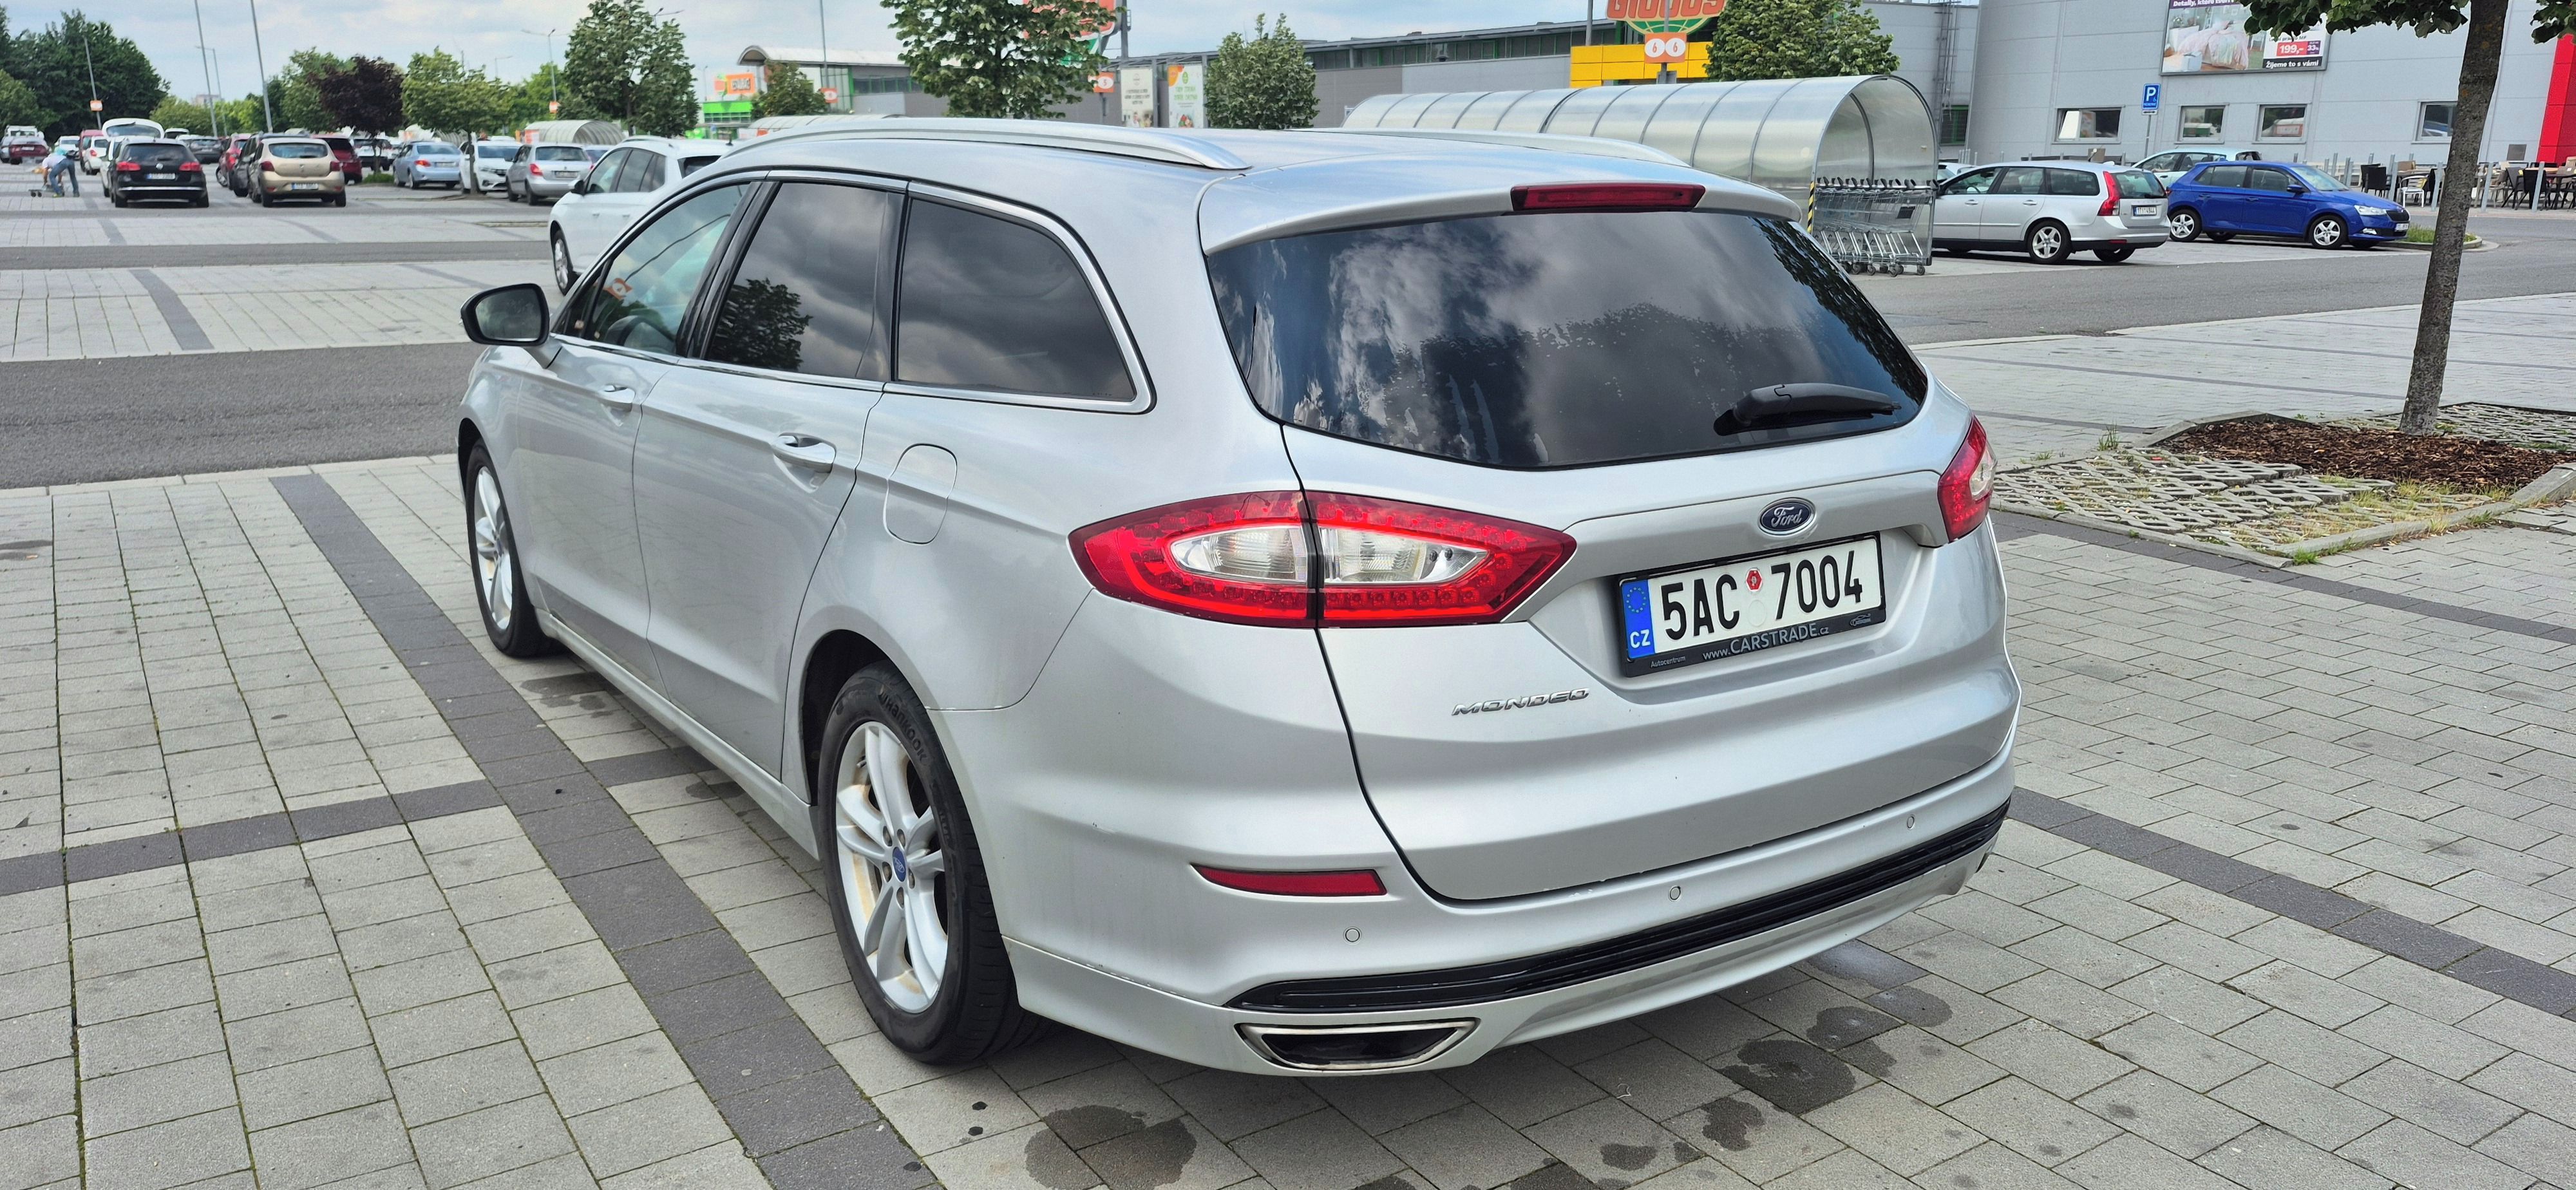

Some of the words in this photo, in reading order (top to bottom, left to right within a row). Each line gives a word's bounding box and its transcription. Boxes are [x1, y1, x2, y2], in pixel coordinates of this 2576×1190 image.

[1653, 42, 1657, 53] 6
[1673, 42, 1678, 53] 6
[2280, 44, 2304, 54] 199,-
[2146, 86, 2156, 101] P
[1771, 507, 1803, 527] Ford
[1661, 574, 1740, 640] 5AC
[1771, 551, 1862, 621] 7004
[1630, 629, 1651, 648] CZ
[1703, 623, 1829, 660] www.CARSTRADE.cz
[1651, 656, 1686, 668] Autocentrum
[1452, 687, 1589, 715] MONDEO
